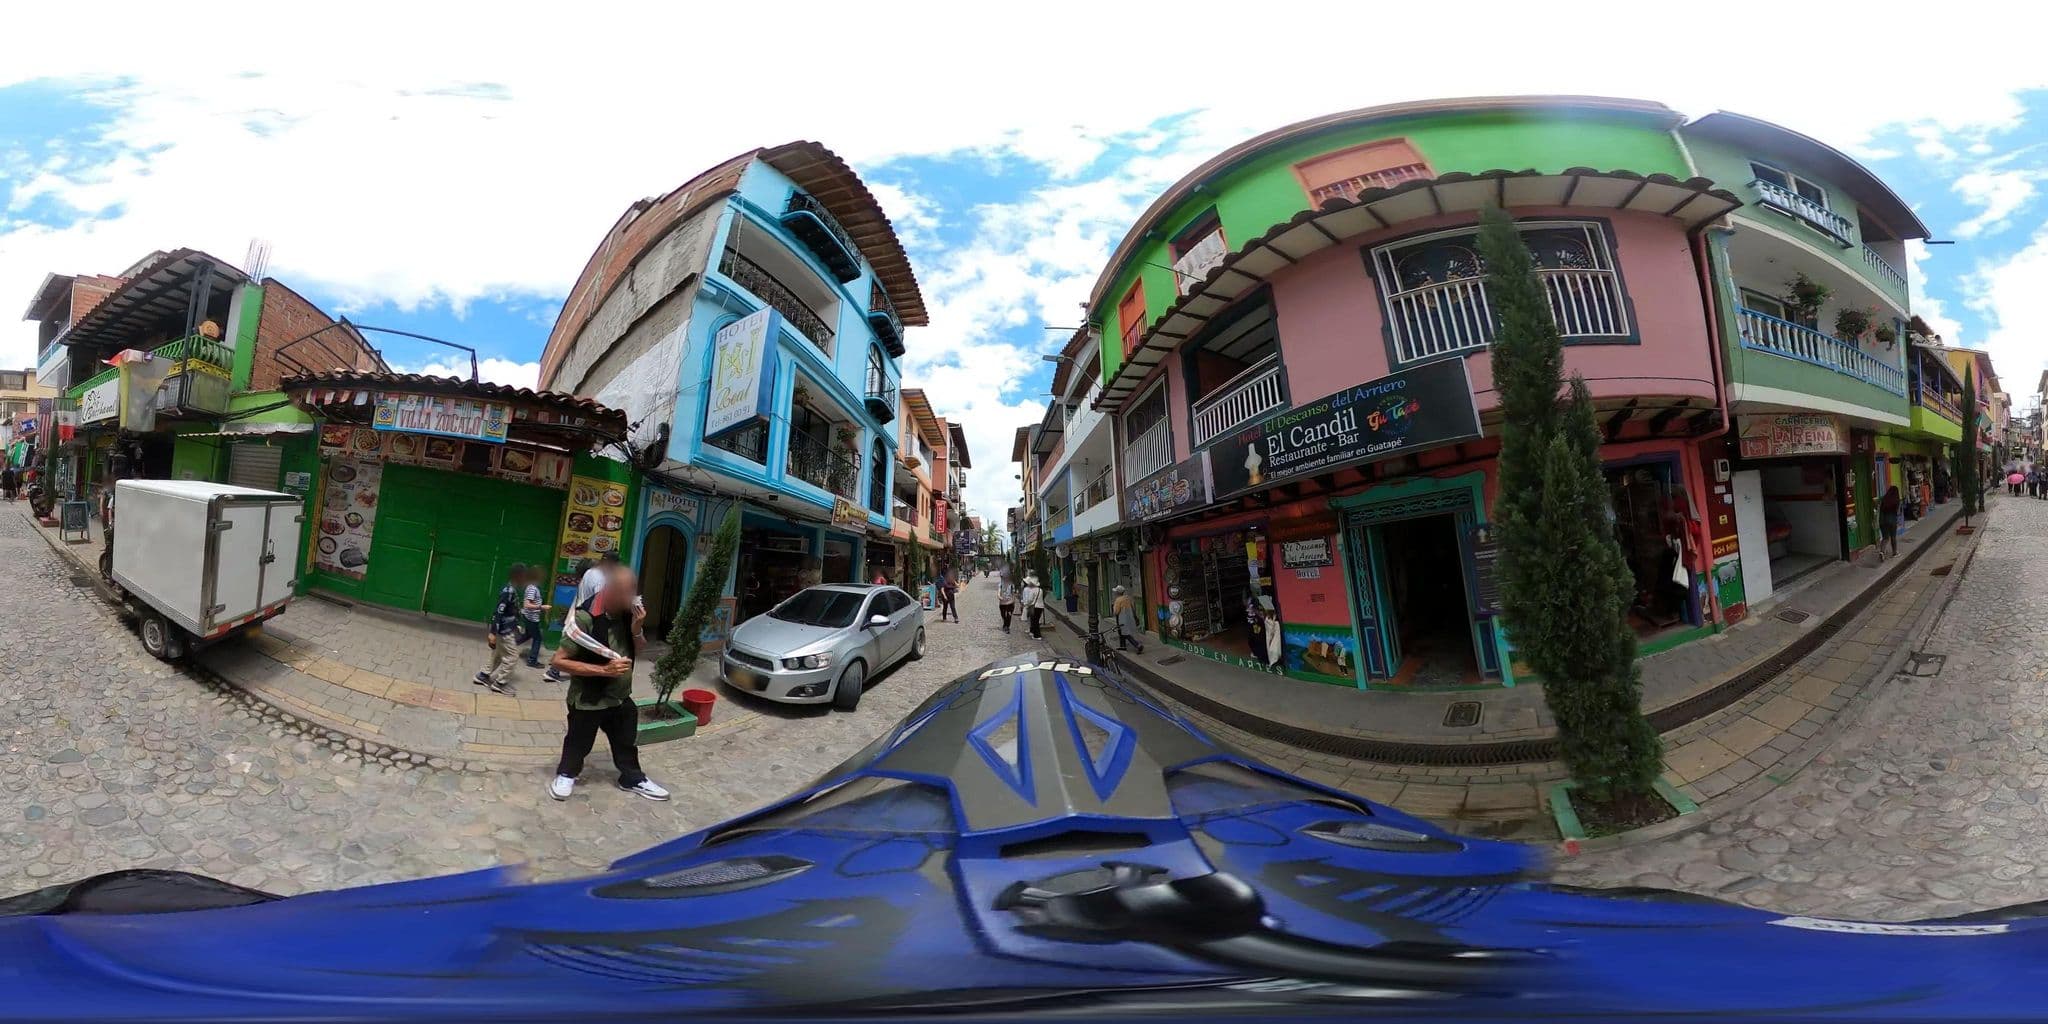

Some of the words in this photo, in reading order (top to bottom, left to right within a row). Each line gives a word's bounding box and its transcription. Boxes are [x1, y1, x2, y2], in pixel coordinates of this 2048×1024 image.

[718, 314, 764, 342] HOTEL
[1265, 420, 1275, 433] El
[1276, 403, 1329, 428] Descanso
[1331, 389, 1352, 408] del
[1354, 379, 1406, 401] Arriero
[1266, 431, 1286, 457] El
[1290, 407, 1358, 447] Candil
[1269, 441, 1328, 468] Restaurante
[1338, 432, 1360, 447] Bar
[1277, 465, 1294, 478] mejor
[1295, 456, 1326, 471] ambiente
[1326, 448, 1354, 463] familiar
[1356, 447, 1366, 456] en
[668, 494, 697, 507] HOTEL
[1183, 642, 1205, 656] TODO
[1215, 651, 1228, 662] EN
[1239, 658, 1283, 676] ARTES
